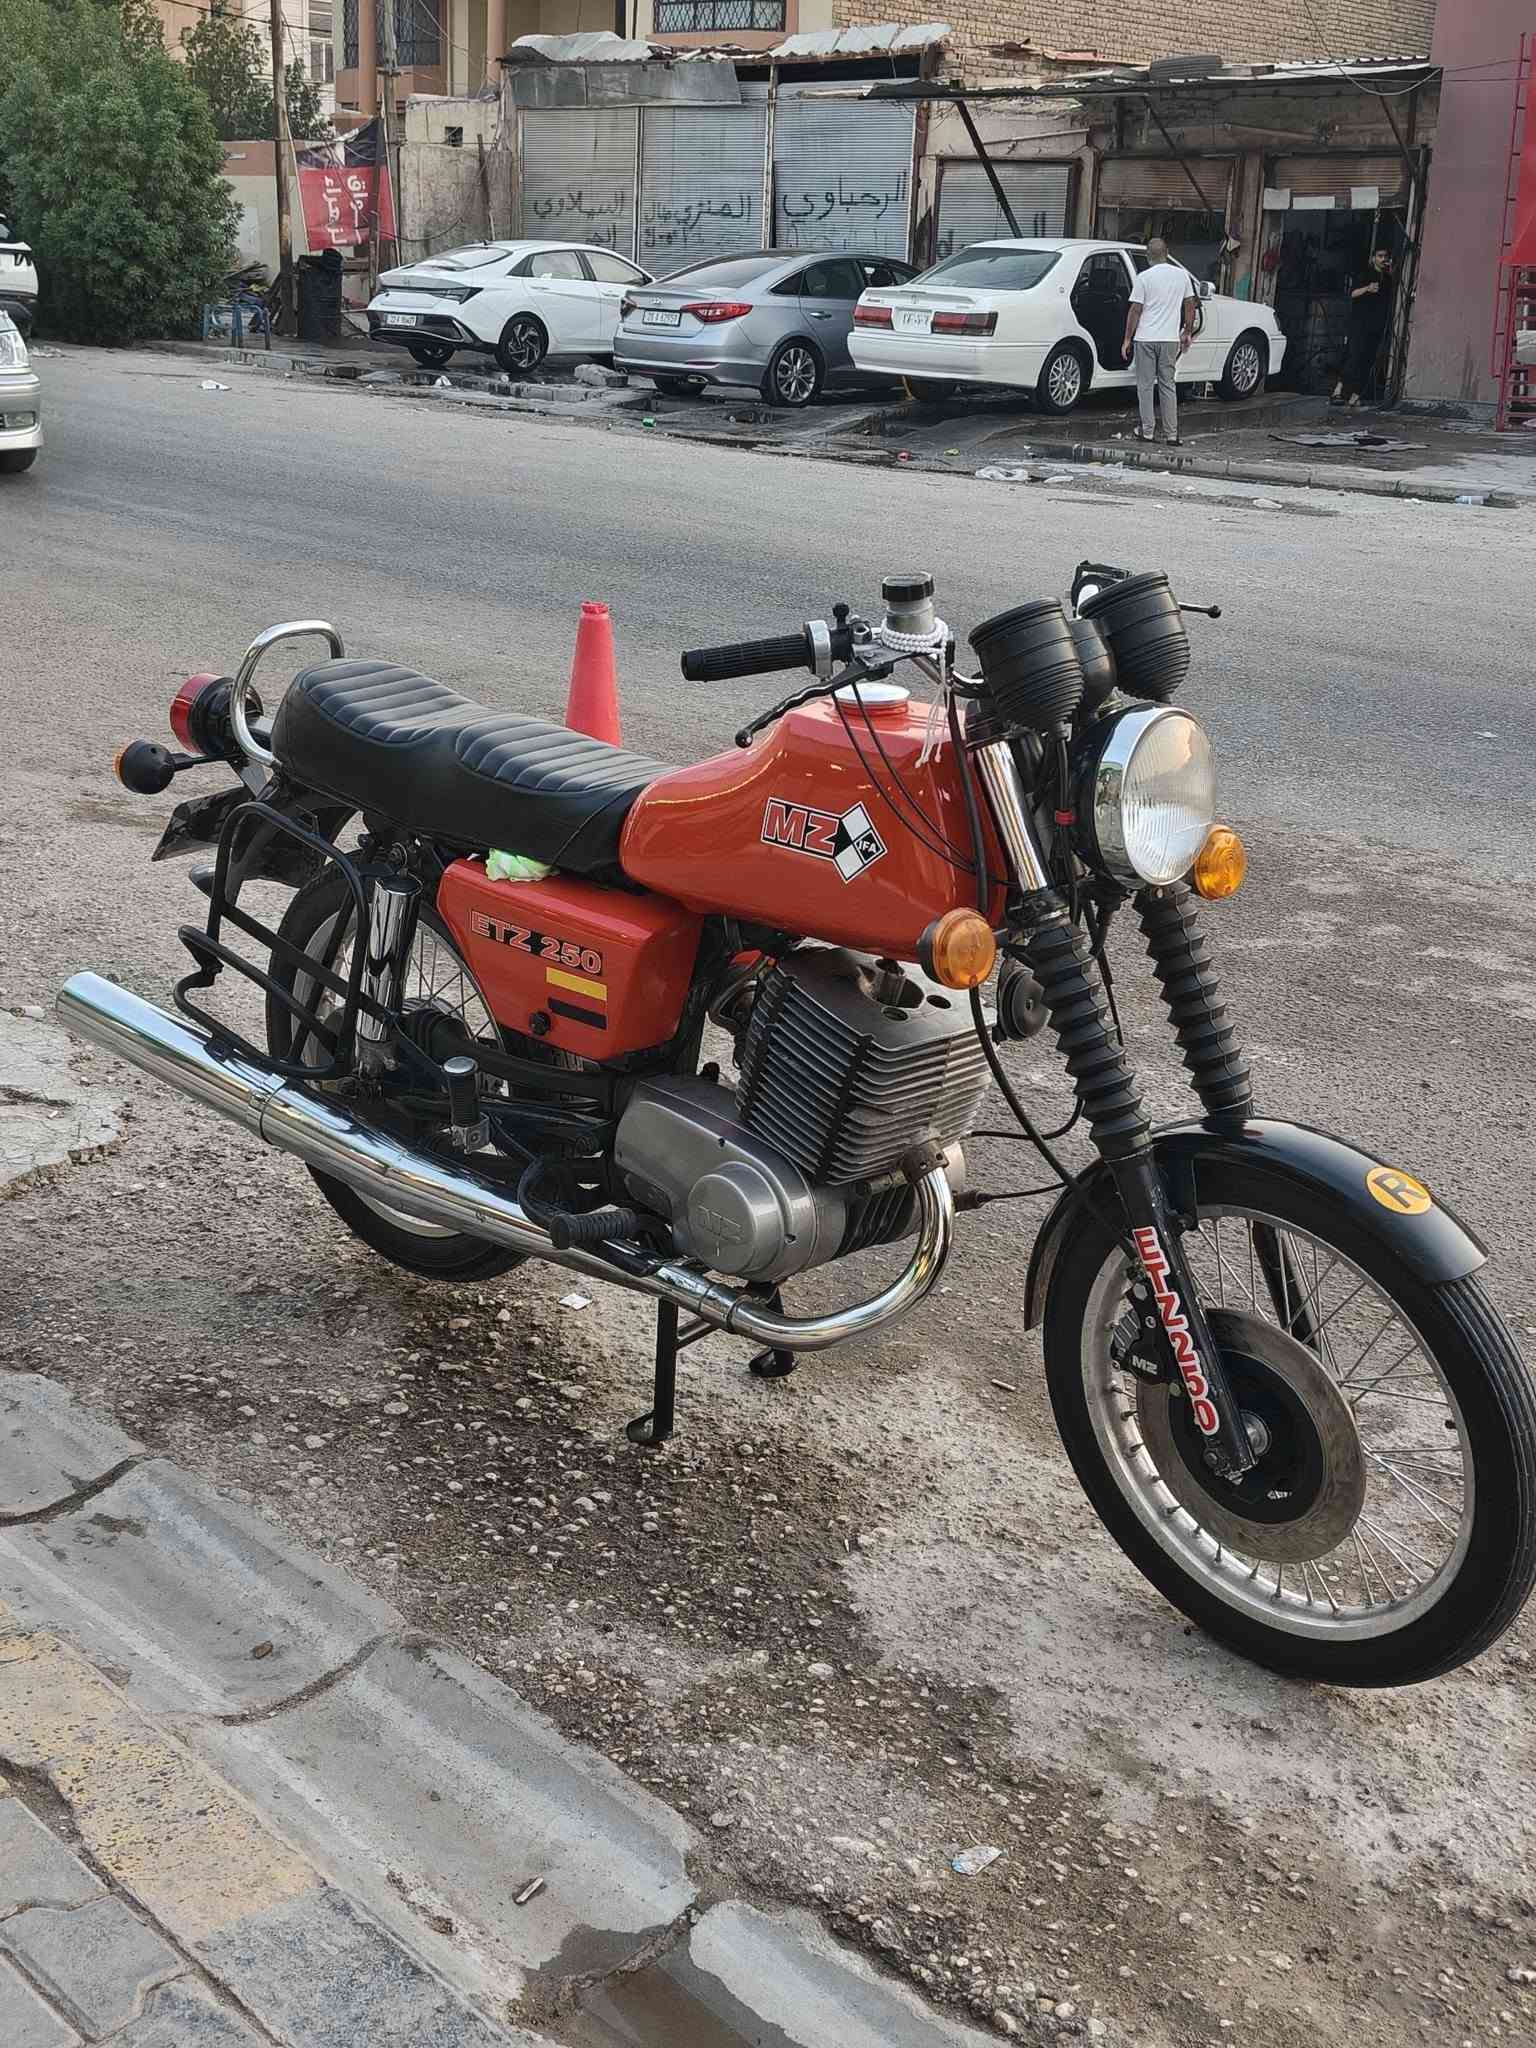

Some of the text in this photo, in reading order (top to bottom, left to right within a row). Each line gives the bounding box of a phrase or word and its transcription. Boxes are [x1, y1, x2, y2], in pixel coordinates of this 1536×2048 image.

[323, 175, 348, 244] لزهراء
[765, 801, 840, 855] MZ
[857, 840, 877, 854] IFA
[471, 911, 602, 974] ETZ 250
[1373, 1173, 1428, 1208] R
[1132, 1355, 1158, 1375] MZ
